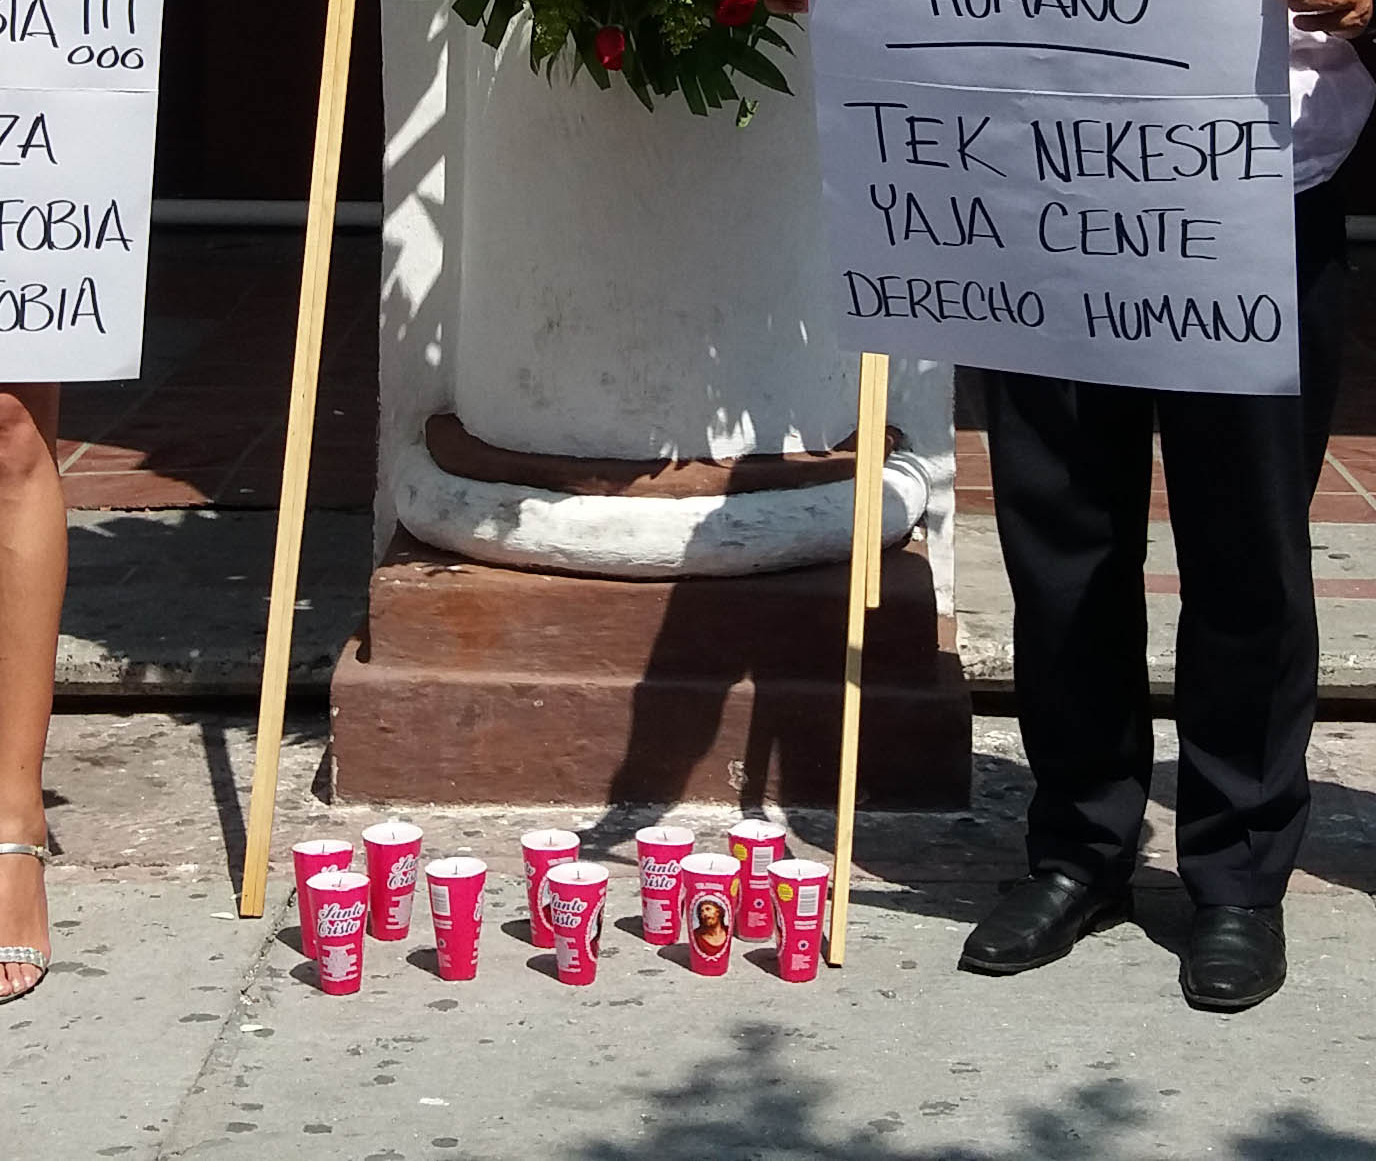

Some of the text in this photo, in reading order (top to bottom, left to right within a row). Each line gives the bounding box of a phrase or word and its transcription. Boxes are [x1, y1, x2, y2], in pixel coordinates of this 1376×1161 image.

[844, 102, 1282, 182] TEK NEKESPE
[870, 184, 1222, 260] YAJA CENTE
[843, 270, 1282, 343] DERECHO HUMANO
[318, 902, 365, 920] Santo
[318, 919, 361, 937] Cristo
